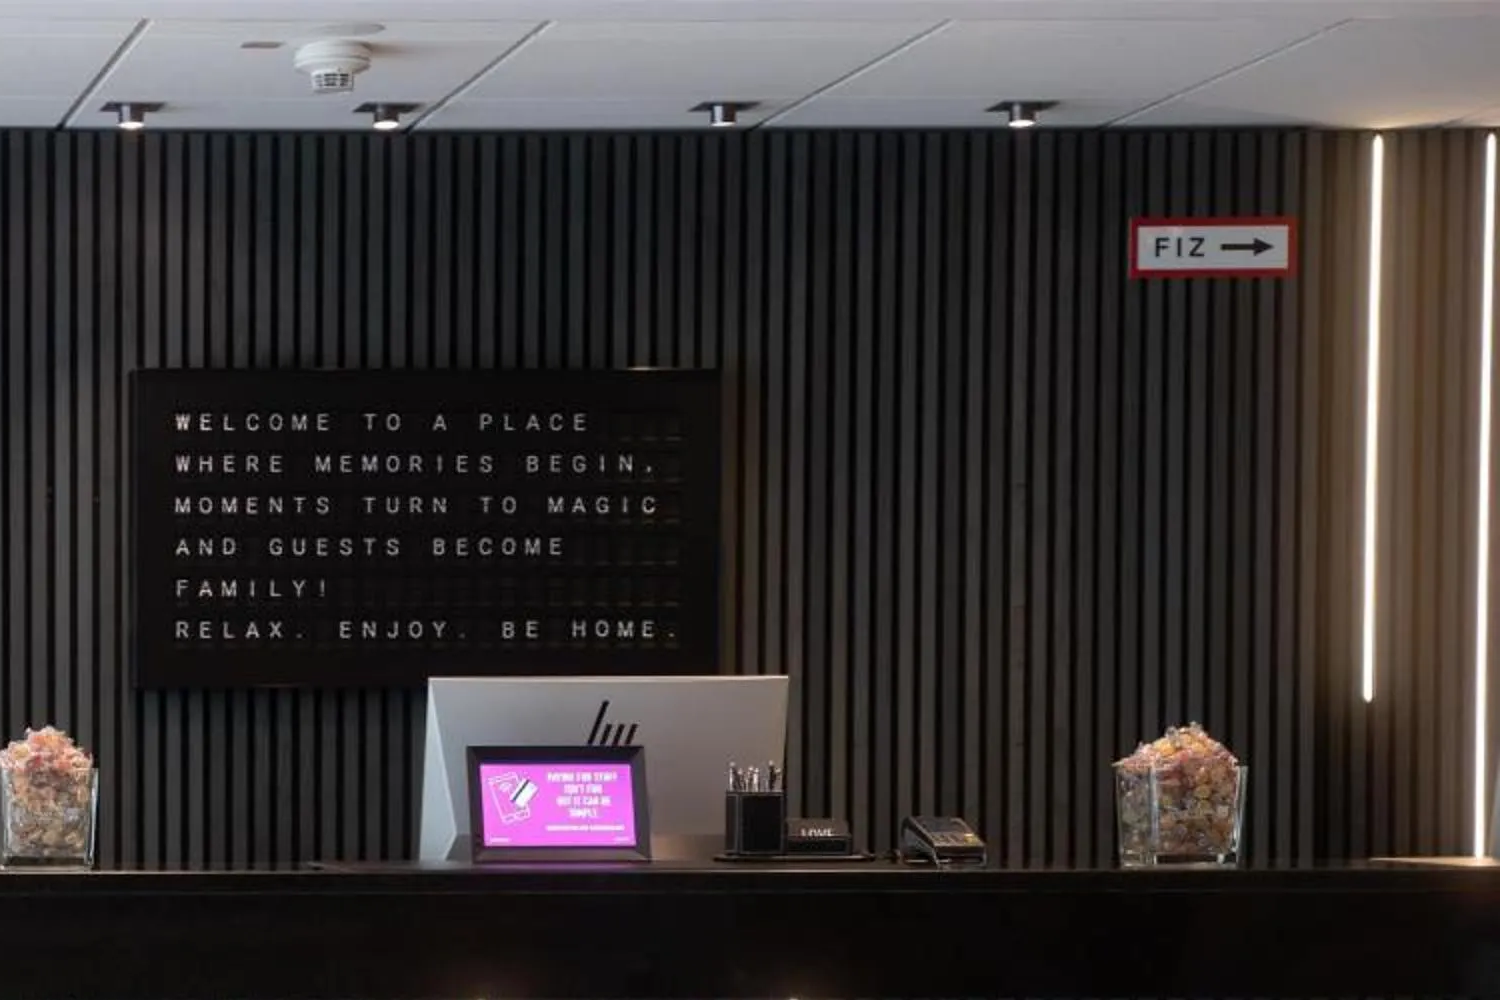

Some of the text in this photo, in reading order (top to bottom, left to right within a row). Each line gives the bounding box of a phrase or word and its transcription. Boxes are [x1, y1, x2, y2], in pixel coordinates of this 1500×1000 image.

[1154, 237, 1205, 257] FIZ
[174, 413, 588, 432] WELCOME TO A PLACE
[174, 454, 283, 474] WHERE
[314, 454, 494, 474] MEMORIES
[174, 495, 657, 515] MOMENTS TURN TO MAGIC
[174, 537, 563, 557] AND GUESTS BECOME
[174, 578, 327, 598] FAMILY!
[174, 620, 303, 640] RELAX.
[501, 620, 539, 640] BE
[570, 619, 676, 640] HOME.
